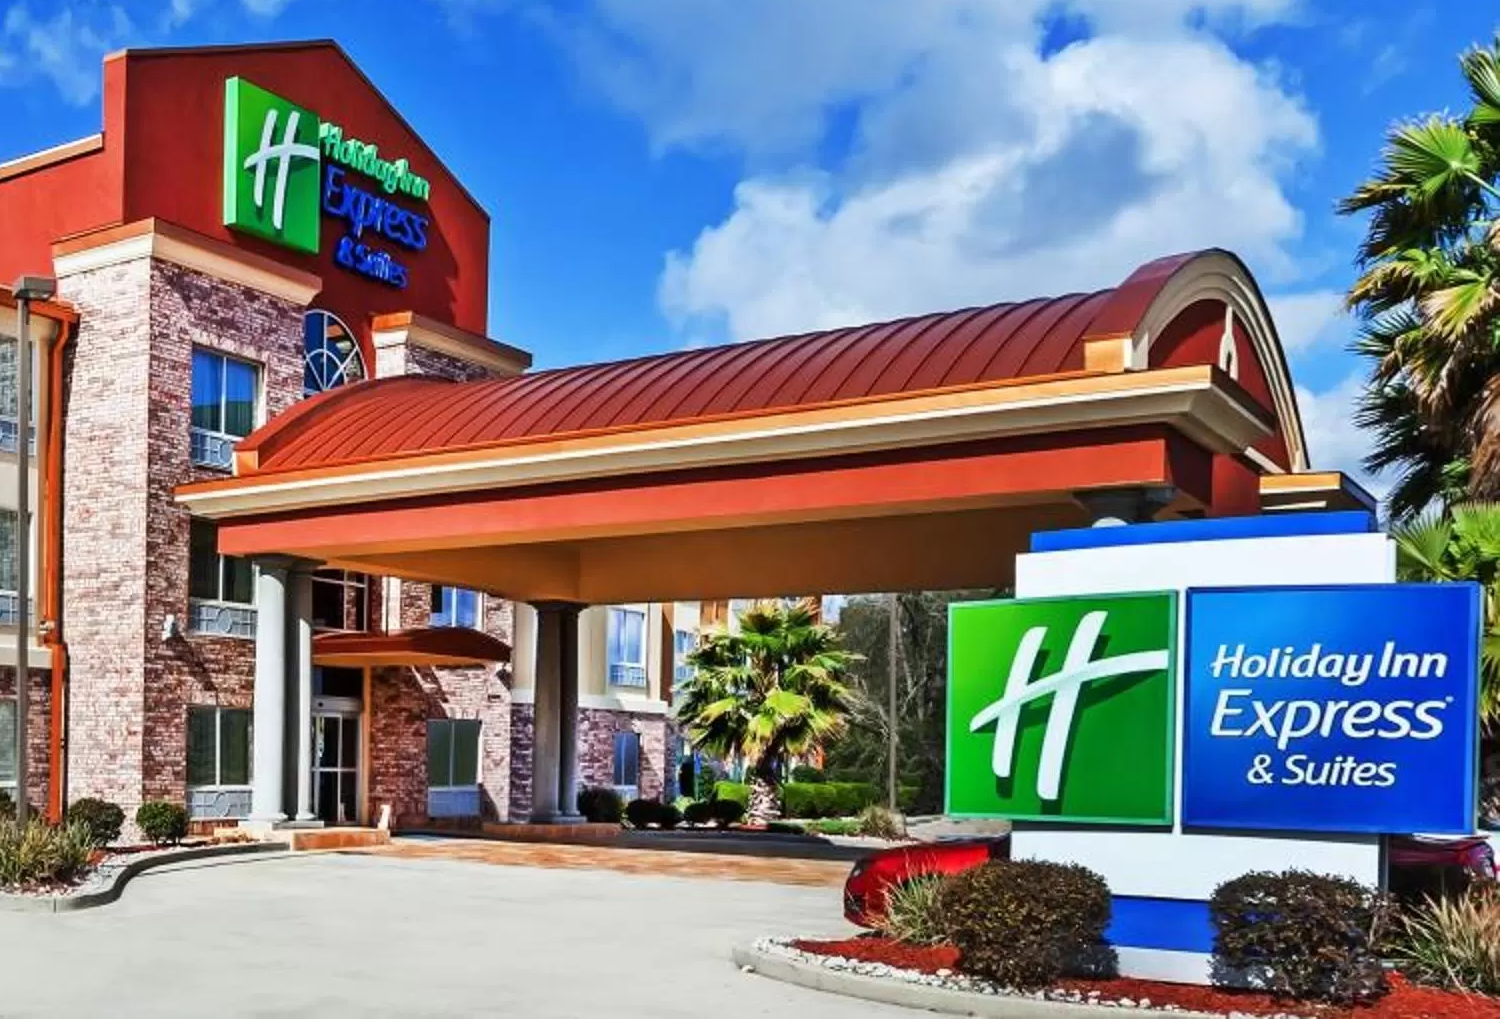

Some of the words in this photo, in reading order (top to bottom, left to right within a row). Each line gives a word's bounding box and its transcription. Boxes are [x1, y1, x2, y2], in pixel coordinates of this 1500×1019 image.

[320, 123, 399, 193] Holiday
[396, 158, 431, 201] Inn
[323, 164, 430, 251] Express
[355, 244, 409, 288] Suites
[1210, 643, 1374, 686] Holiday
[1378, 641, 1448, 678] Inn
[1210, 688, 1448, 750] Express
[1247, 754, 1274, 784] &
[1282, 754, 1397, 786] Suites
